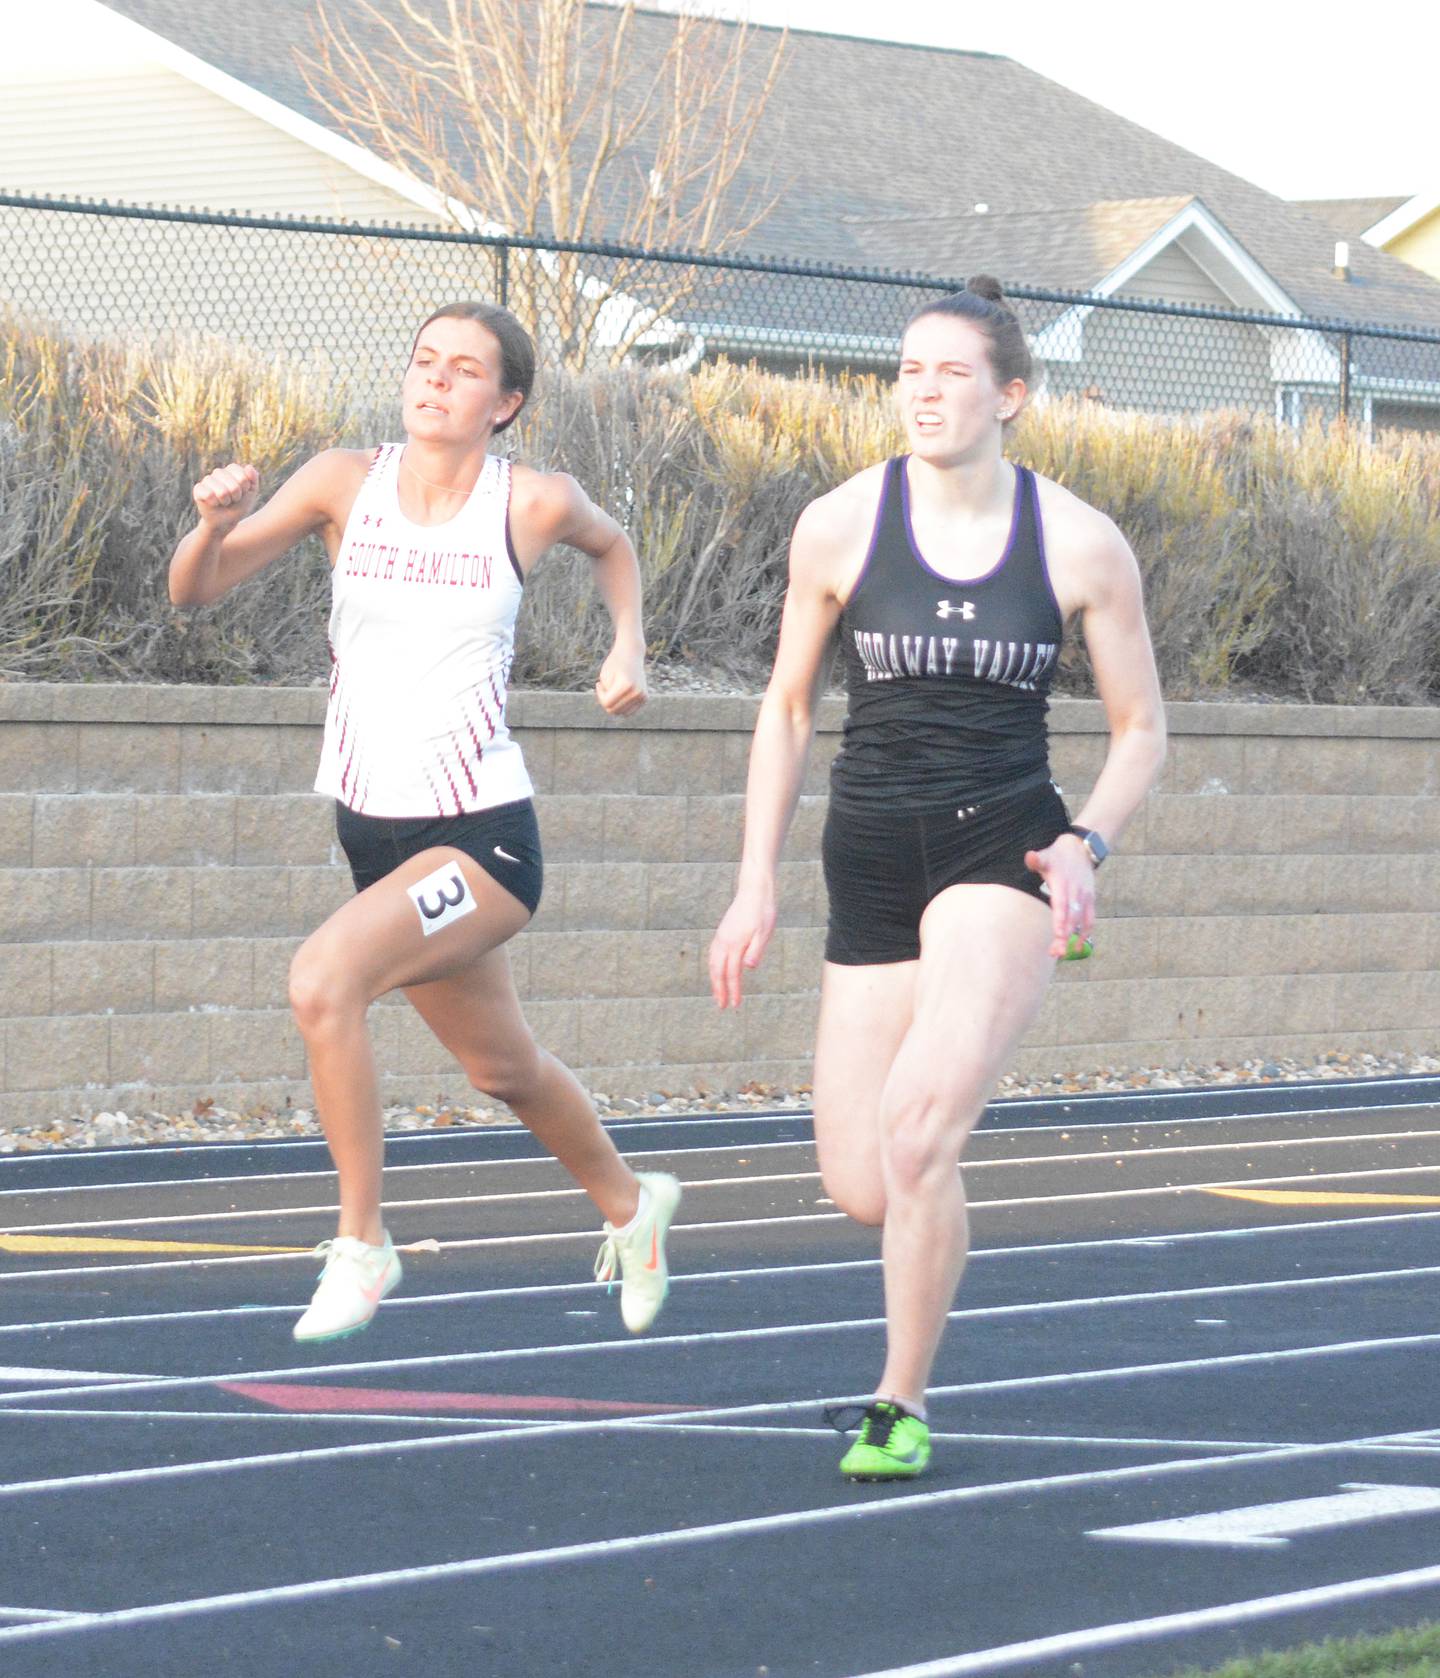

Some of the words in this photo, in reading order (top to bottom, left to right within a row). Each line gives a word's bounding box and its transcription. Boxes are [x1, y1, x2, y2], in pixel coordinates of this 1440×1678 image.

[346, 541, 399, 580] SOUTH
[403, 549, 493, 589] HAMILTON
[417, 874, 465, 919] 3
